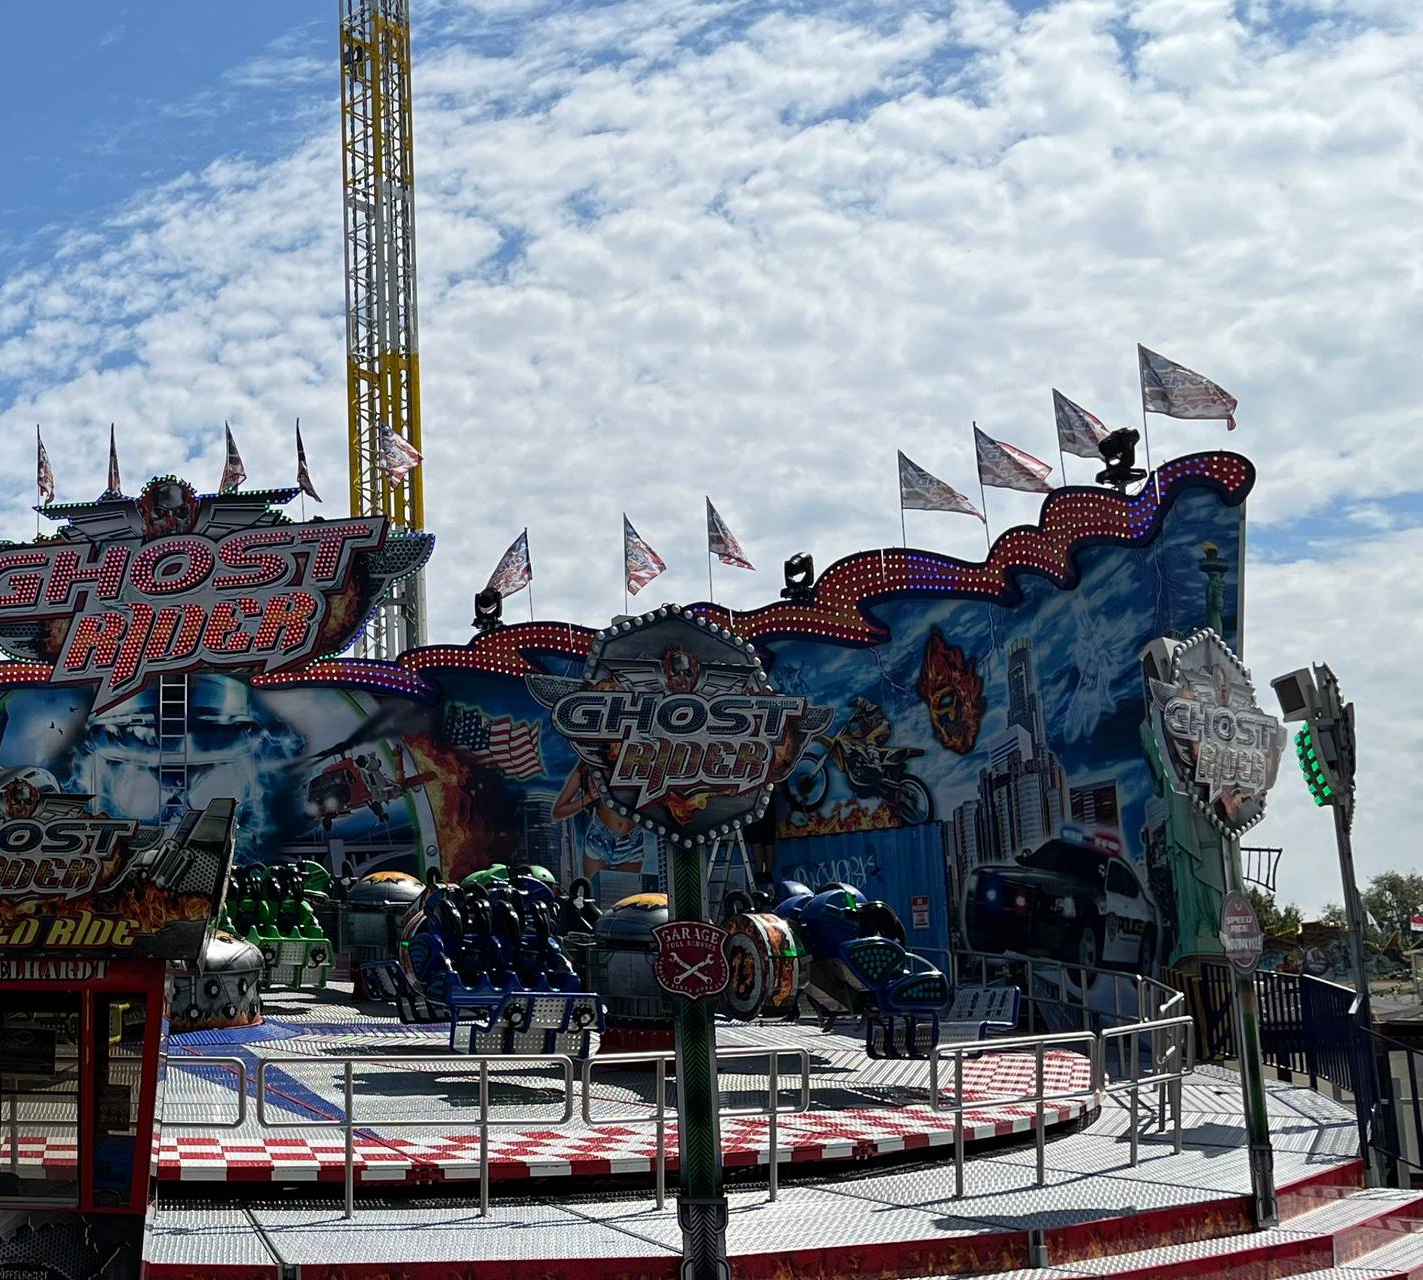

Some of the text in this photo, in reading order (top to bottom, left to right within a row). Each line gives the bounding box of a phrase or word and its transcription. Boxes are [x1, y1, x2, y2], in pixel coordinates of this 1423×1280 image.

[63, 591, 317, 688] RIDER
[555, 697, 799, 734] GHOST
[1166, 700, 1275, 750] GHOST
[617, 738, 769, 797] RIDER
[45, 911, 140, 946] RIDE
[661, 927, 719, 945] GARAGE
